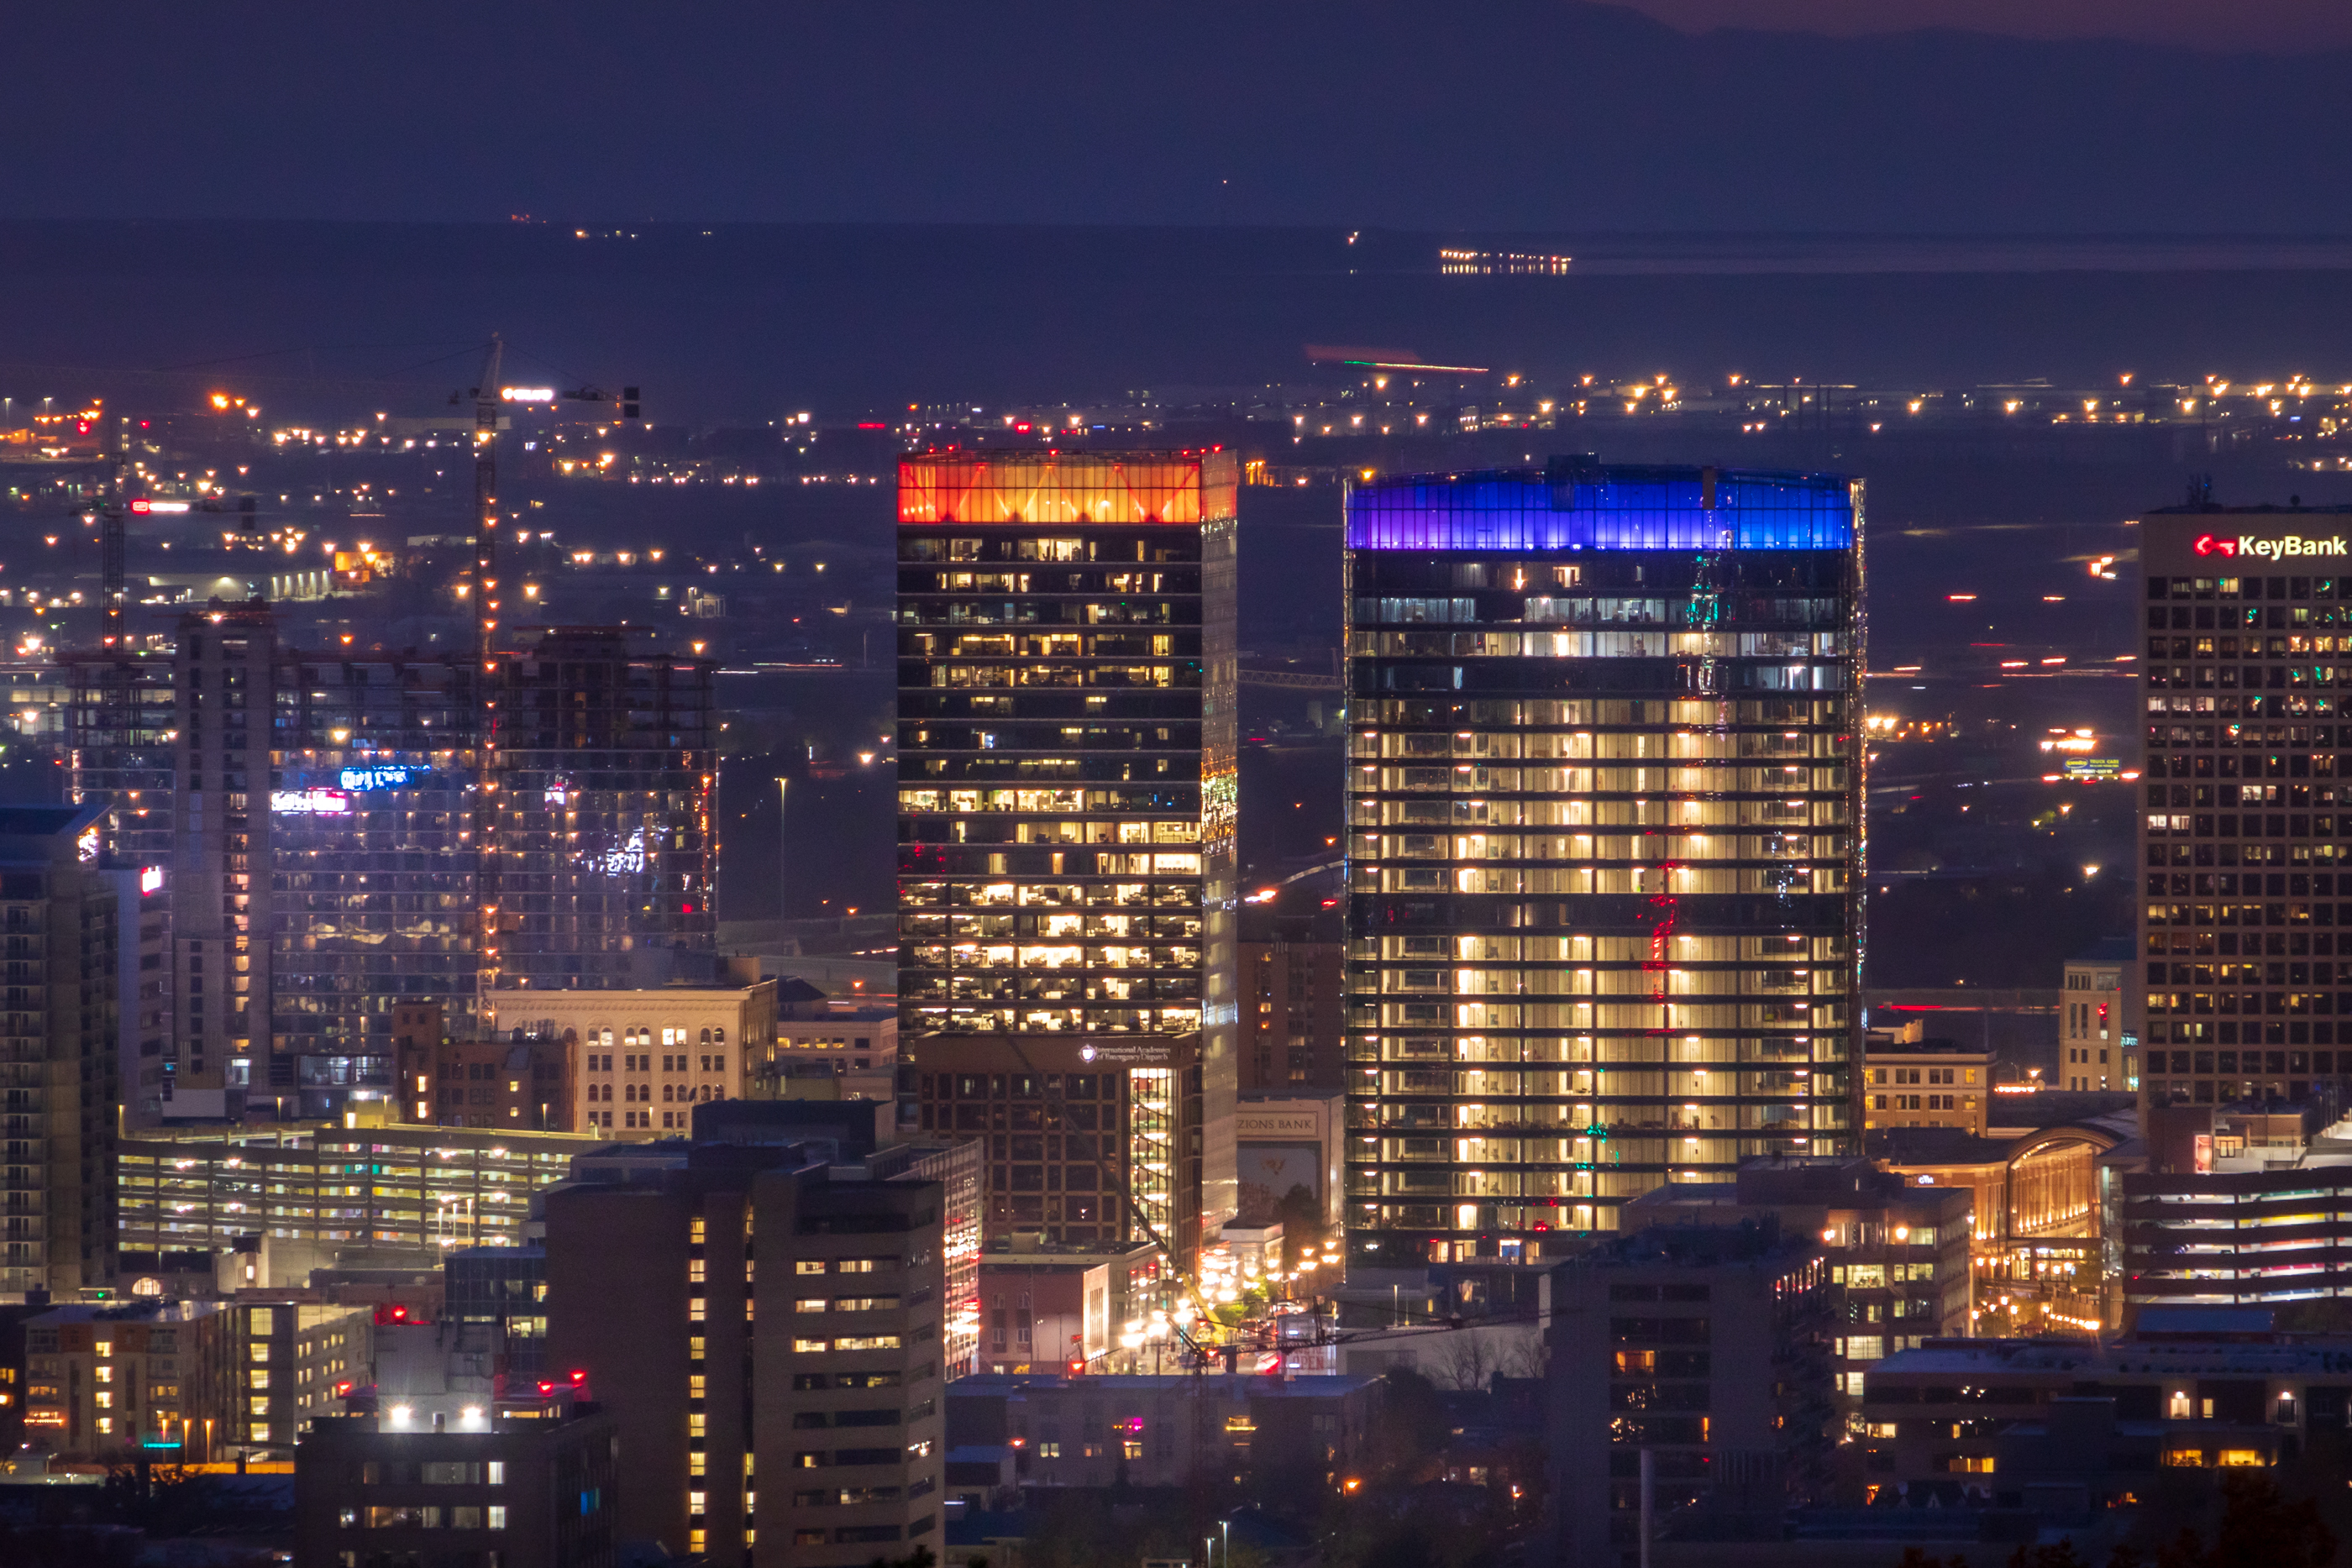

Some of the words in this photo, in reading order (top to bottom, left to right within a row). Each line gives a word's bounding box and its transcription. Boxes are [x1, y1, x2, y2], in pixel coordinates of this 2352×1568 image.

[2238, 535, 2348, 561] KeyBank
[1105, 1053, 1141, 1062] Emergency
[1141, 1053, 1168, 1062] Dispatch
[1237, 1120, 1274, 1129] ZIONS
[1278, 1120, 1312, 1129] BANK
[1293, 1356, 1324, 1370] OPEN
